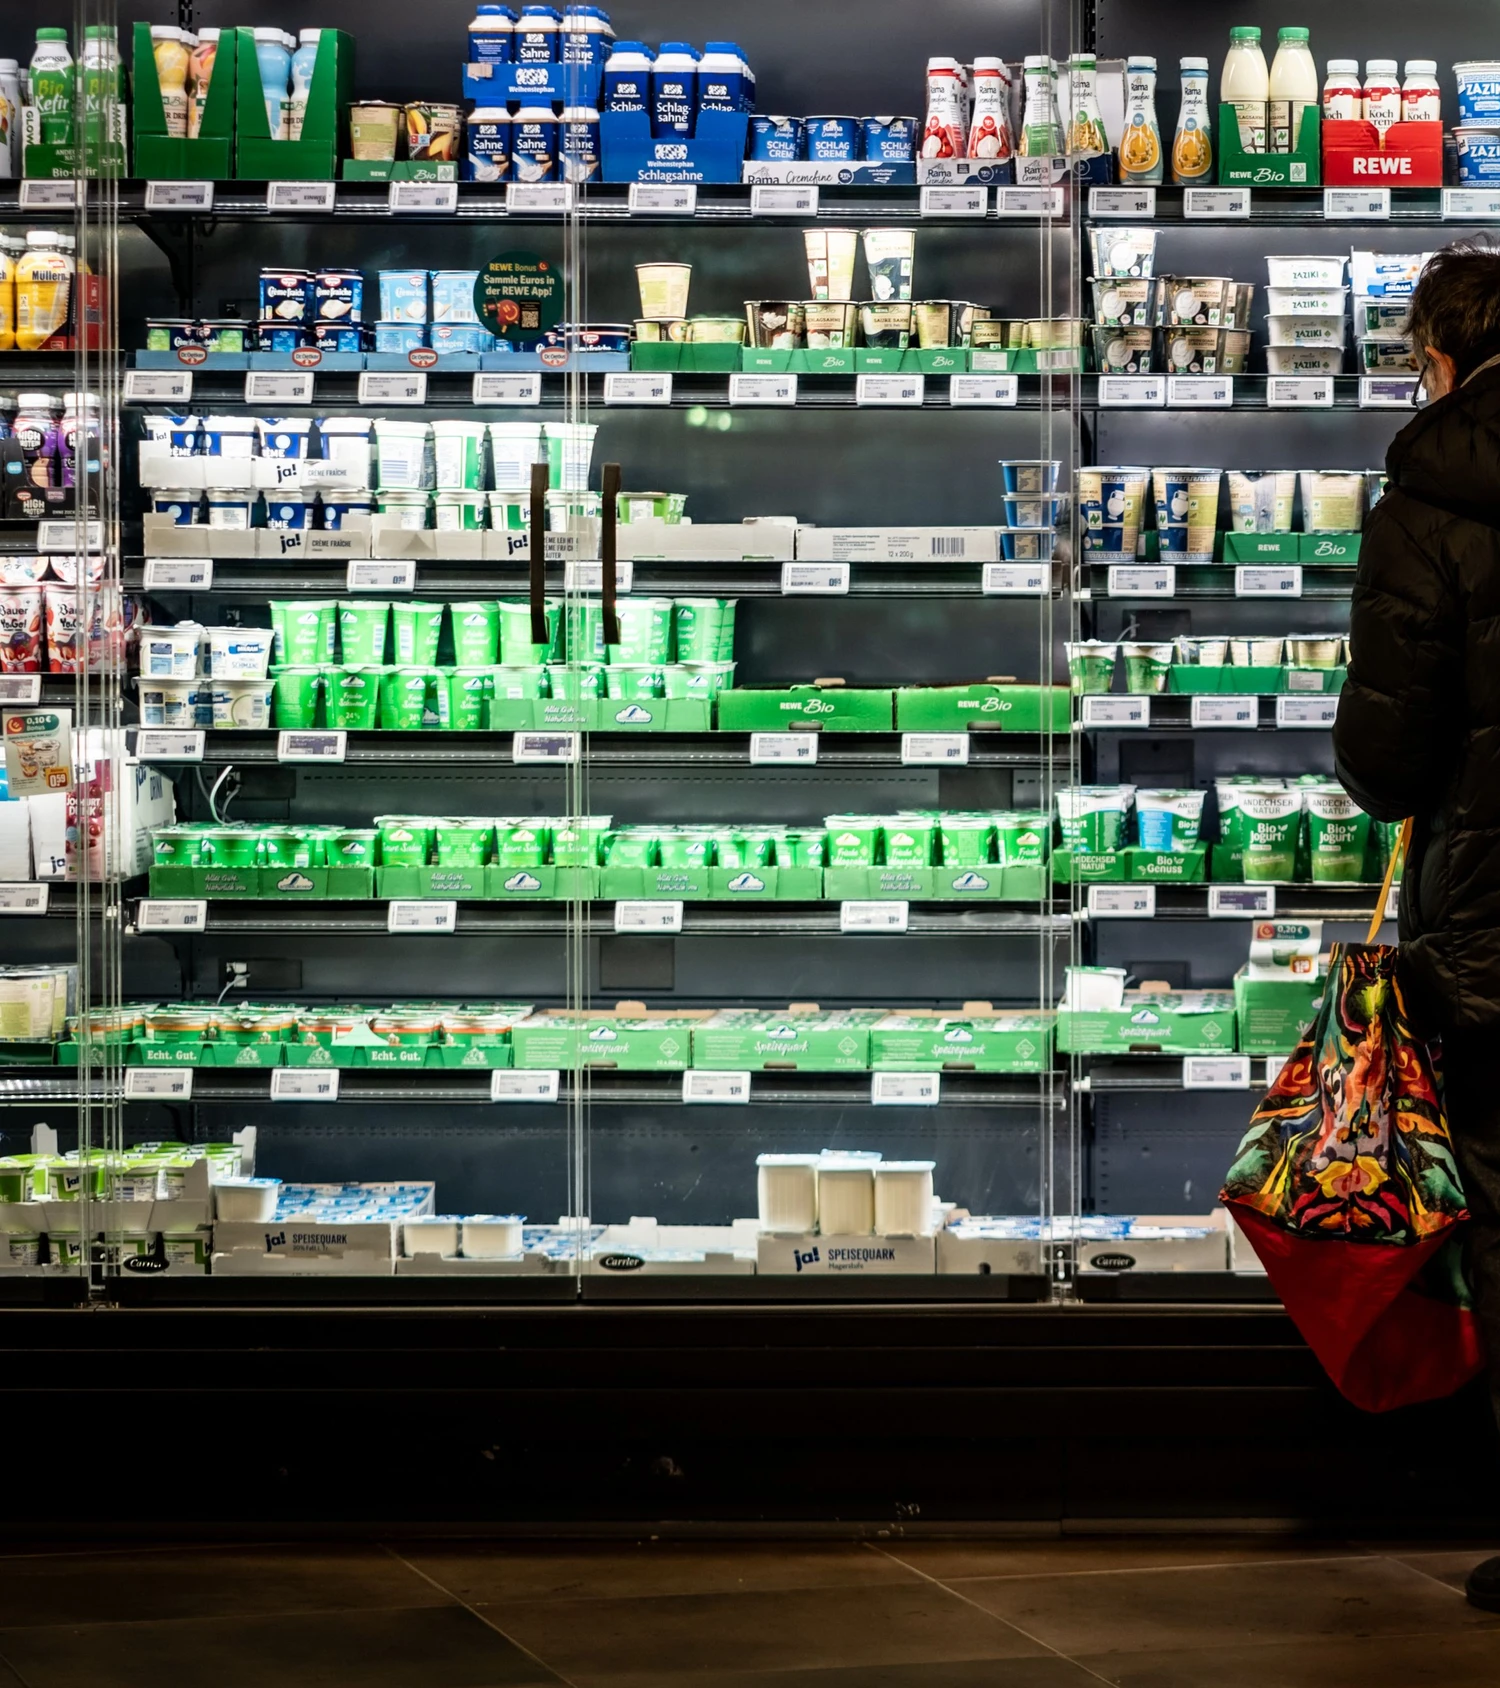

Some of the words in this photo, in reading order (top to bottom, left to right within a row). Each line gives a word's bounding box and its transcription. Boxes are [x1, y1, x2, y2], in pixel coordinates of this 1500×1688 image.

[520, 48, 550, 60] Sahne
[38, 80, 63, 96] Bio
[508, 86, 555, 95] Weihenstephan
[979, 85, 997, 93] Rama
[1131, 83, 1148, 91] Rama
[35, 94, 69, 114] Kefir
[611, 101, 646, 112] Schlag-
[657, 102, 691, 115] Schlag-
[658, 112, 687, 122] sahne
[1368, 109, 1394, 119] Koch
[1407, 111, 1430, 120] Koch
[473, 139, 503, 150] Sahne
[517, 139, 546, 149] Sahne
[767, 141, 795, 150] SCHLAG
[815, 142, 850, 152] SCHLAG
[881, 142, 912, 152] SCHLAG
[769, 149, 795, 160] CREME
[817, 151, 848, 160] CREME
[883, 151, 910, 160] CREME
[647, 160, 694, 169] Weihenstephan
[1024, 166, 1048, 174] Rama
[1353, 157, 1412, 175] REWE
[414, 170, 436, 181] Bio
[638, 169, 703, 184] Schlagsahne
[747, 175, 779, 184] Rama
[786, 170, 832, 184] Cremefine
[928, 168, 952, 177] Rama
[1230, 171, 1252, 179] REWE
[1253, 168, 1285, 182] Bio
[489, 262, 513, 272] REWE
[515, 263, 537, 272] Bonus
[483, 274, 519, 284] Sammle
[520, 274, 545, 285] Euros
[546, 275, 555, 284] in
[1292, 270, 1319, 280] ZAZIKI
[485, 286, 500, 295] der
[502, 286, 530, 295] REWE
[531, 286, 553, 298] App!
[1292, 300, 1319, 309] ZAZIKI
[1295, 329, 1322, 338] ZAZIKI
[822, 356, 845, 368] Bio
[932, 356, 954, 368] Bio
[1293, 360, 1321, 370] ZAZIKI
[17, 430, 41, 440] HIGH
[156, 431, 167, 442] ja!
[276, 463, 297, 484] ja!
[308, 468, 325, 477] CRÈME
[325, 468, 347, 477] FRAÎCHE
[23, 499, 45, 509] HIGH
[279, 533, 301, 554] ja!
[312, 538, 329, 547] CRÈME
[330, 538, 352, 547] FRAÎCHE
[507, 534, 528, 555] ja!
[1314, 541, 1346, 556] Bio
[0, 605, 28, 616] Bauer
[780, 702, 802, 710] REWE
[803, 698, 835, 714] Bio
[958, 700, 980, 708] REWE
[981, 697, 1012, 712] Bio
[26, 716, 45, 725] 0,10
[1243, 799, 1293, 807] ANDECHSER
[1312, 799, 1358, 807] ANDECHSE
[1322, 807, 1350, 815] NATUR
[1257, 823, 1276, 833] Bio
[1327, 823, 1346, 834] Bio
[1250, 830, 1282, 844] Jogurt
[1319, 831, 1352, 844] Jogurt
[50, 856, 65, 874] ja
[1070, 855, 1116, 864] ANDECHSER
[1157, 855, 1173, 865] Bio
[1147, 863, 1183, 874] Genuss
[1277, 925, 1296, 934] 0,20
[1118, 1026, 1173, 1041] Speisequark
[754, 1040, 809, 1056] Speisequark
[931, 1043, 986, 1058] Speisequark
[147, 1050, 173, 1060] Echt.
[176, 1051, 197, 1060] Gut.
[371, 1050, 397, 1061] Echt.
[400, 1051, 421, 1061] Gut.
[264, 1231, 287, 1252] ja!
[292, 1232, 347, 1245] SPEISEQUARK
[794, 1246, 820, 1272] ja!
[827, 1248, 895, 1263] SPEISEQUARK
[129, 1258, 161, 1270] Carrier
[605, 1256, 640, 1268] Carrier
[828, 1262, 864, 1271] Magerstufe
[1095, 1256, 1132, 1267] Carrier
